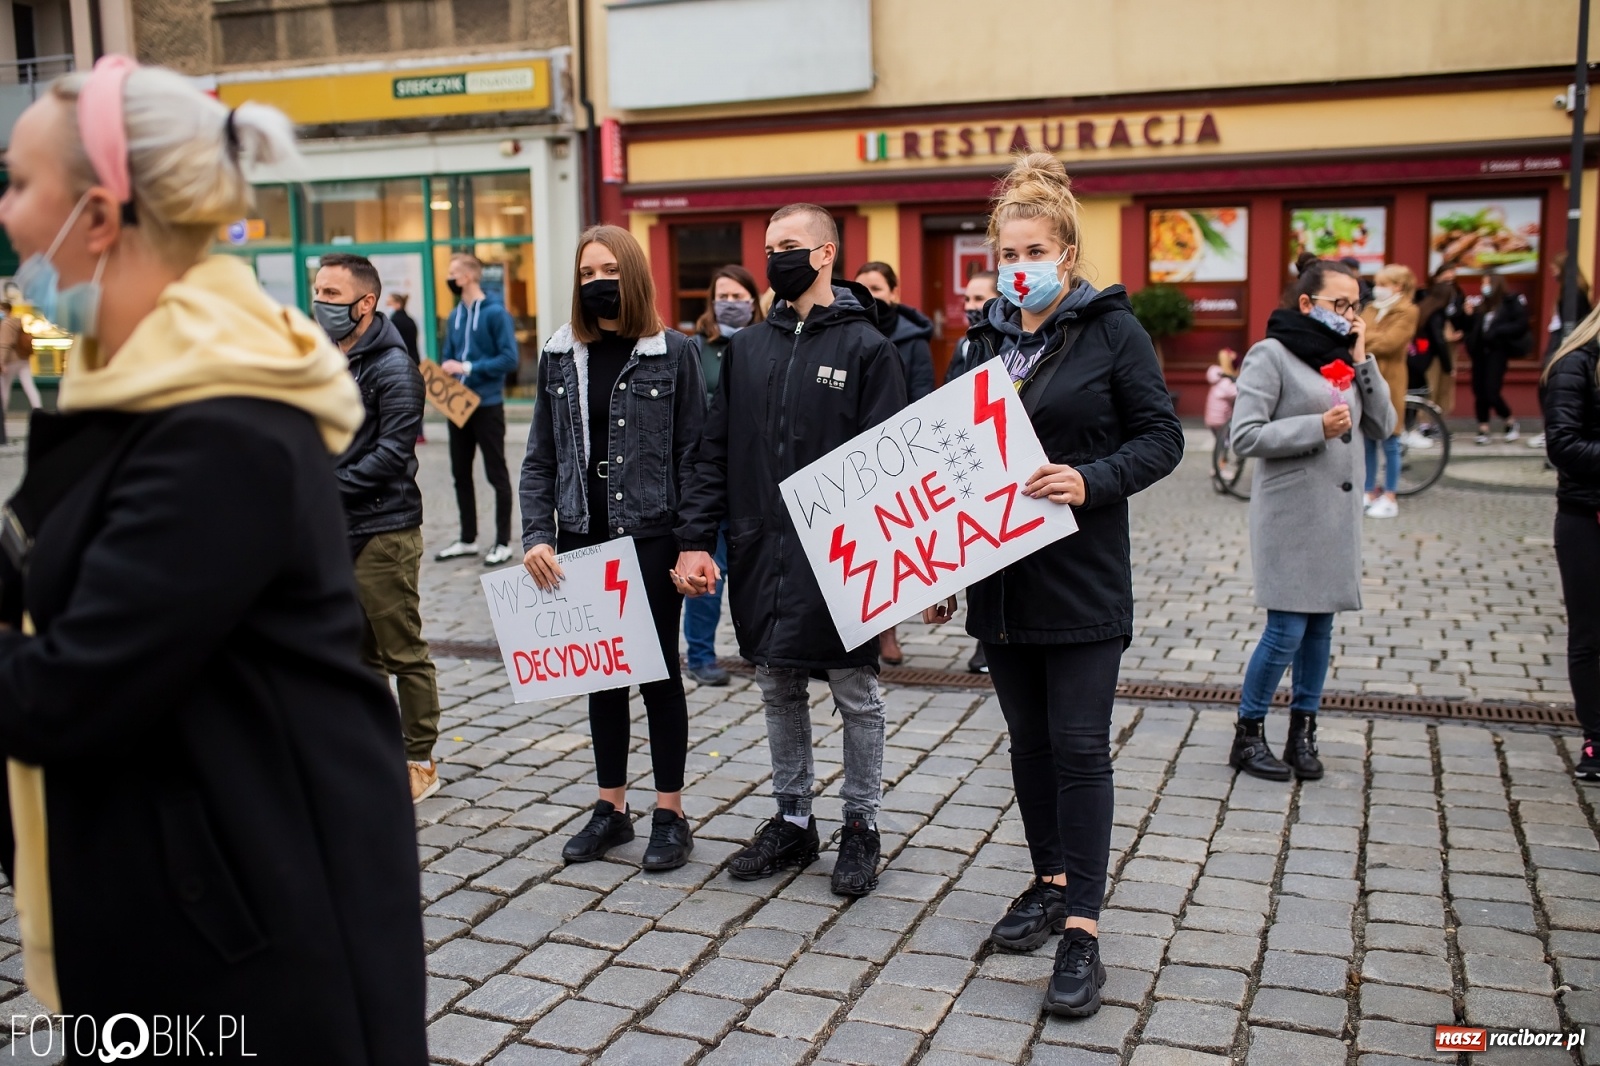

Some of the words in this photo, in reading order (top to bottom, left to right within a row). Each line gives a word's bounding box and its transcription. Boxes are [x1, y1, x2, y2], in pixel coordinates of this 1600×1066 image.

[395, 76, 464, 98] STEFCZYK
[903, 112, 1220, 159] RESTAURACJA
[794, 417, 939, 529] WYBÓR
[874, 470, 956, 542] NIE
[848, 482, 1045, 623] ZAKAZ
[534, 604, 602, 638] CZUJĘ
[513, 636, 632, 685] DECYDUJĘ
